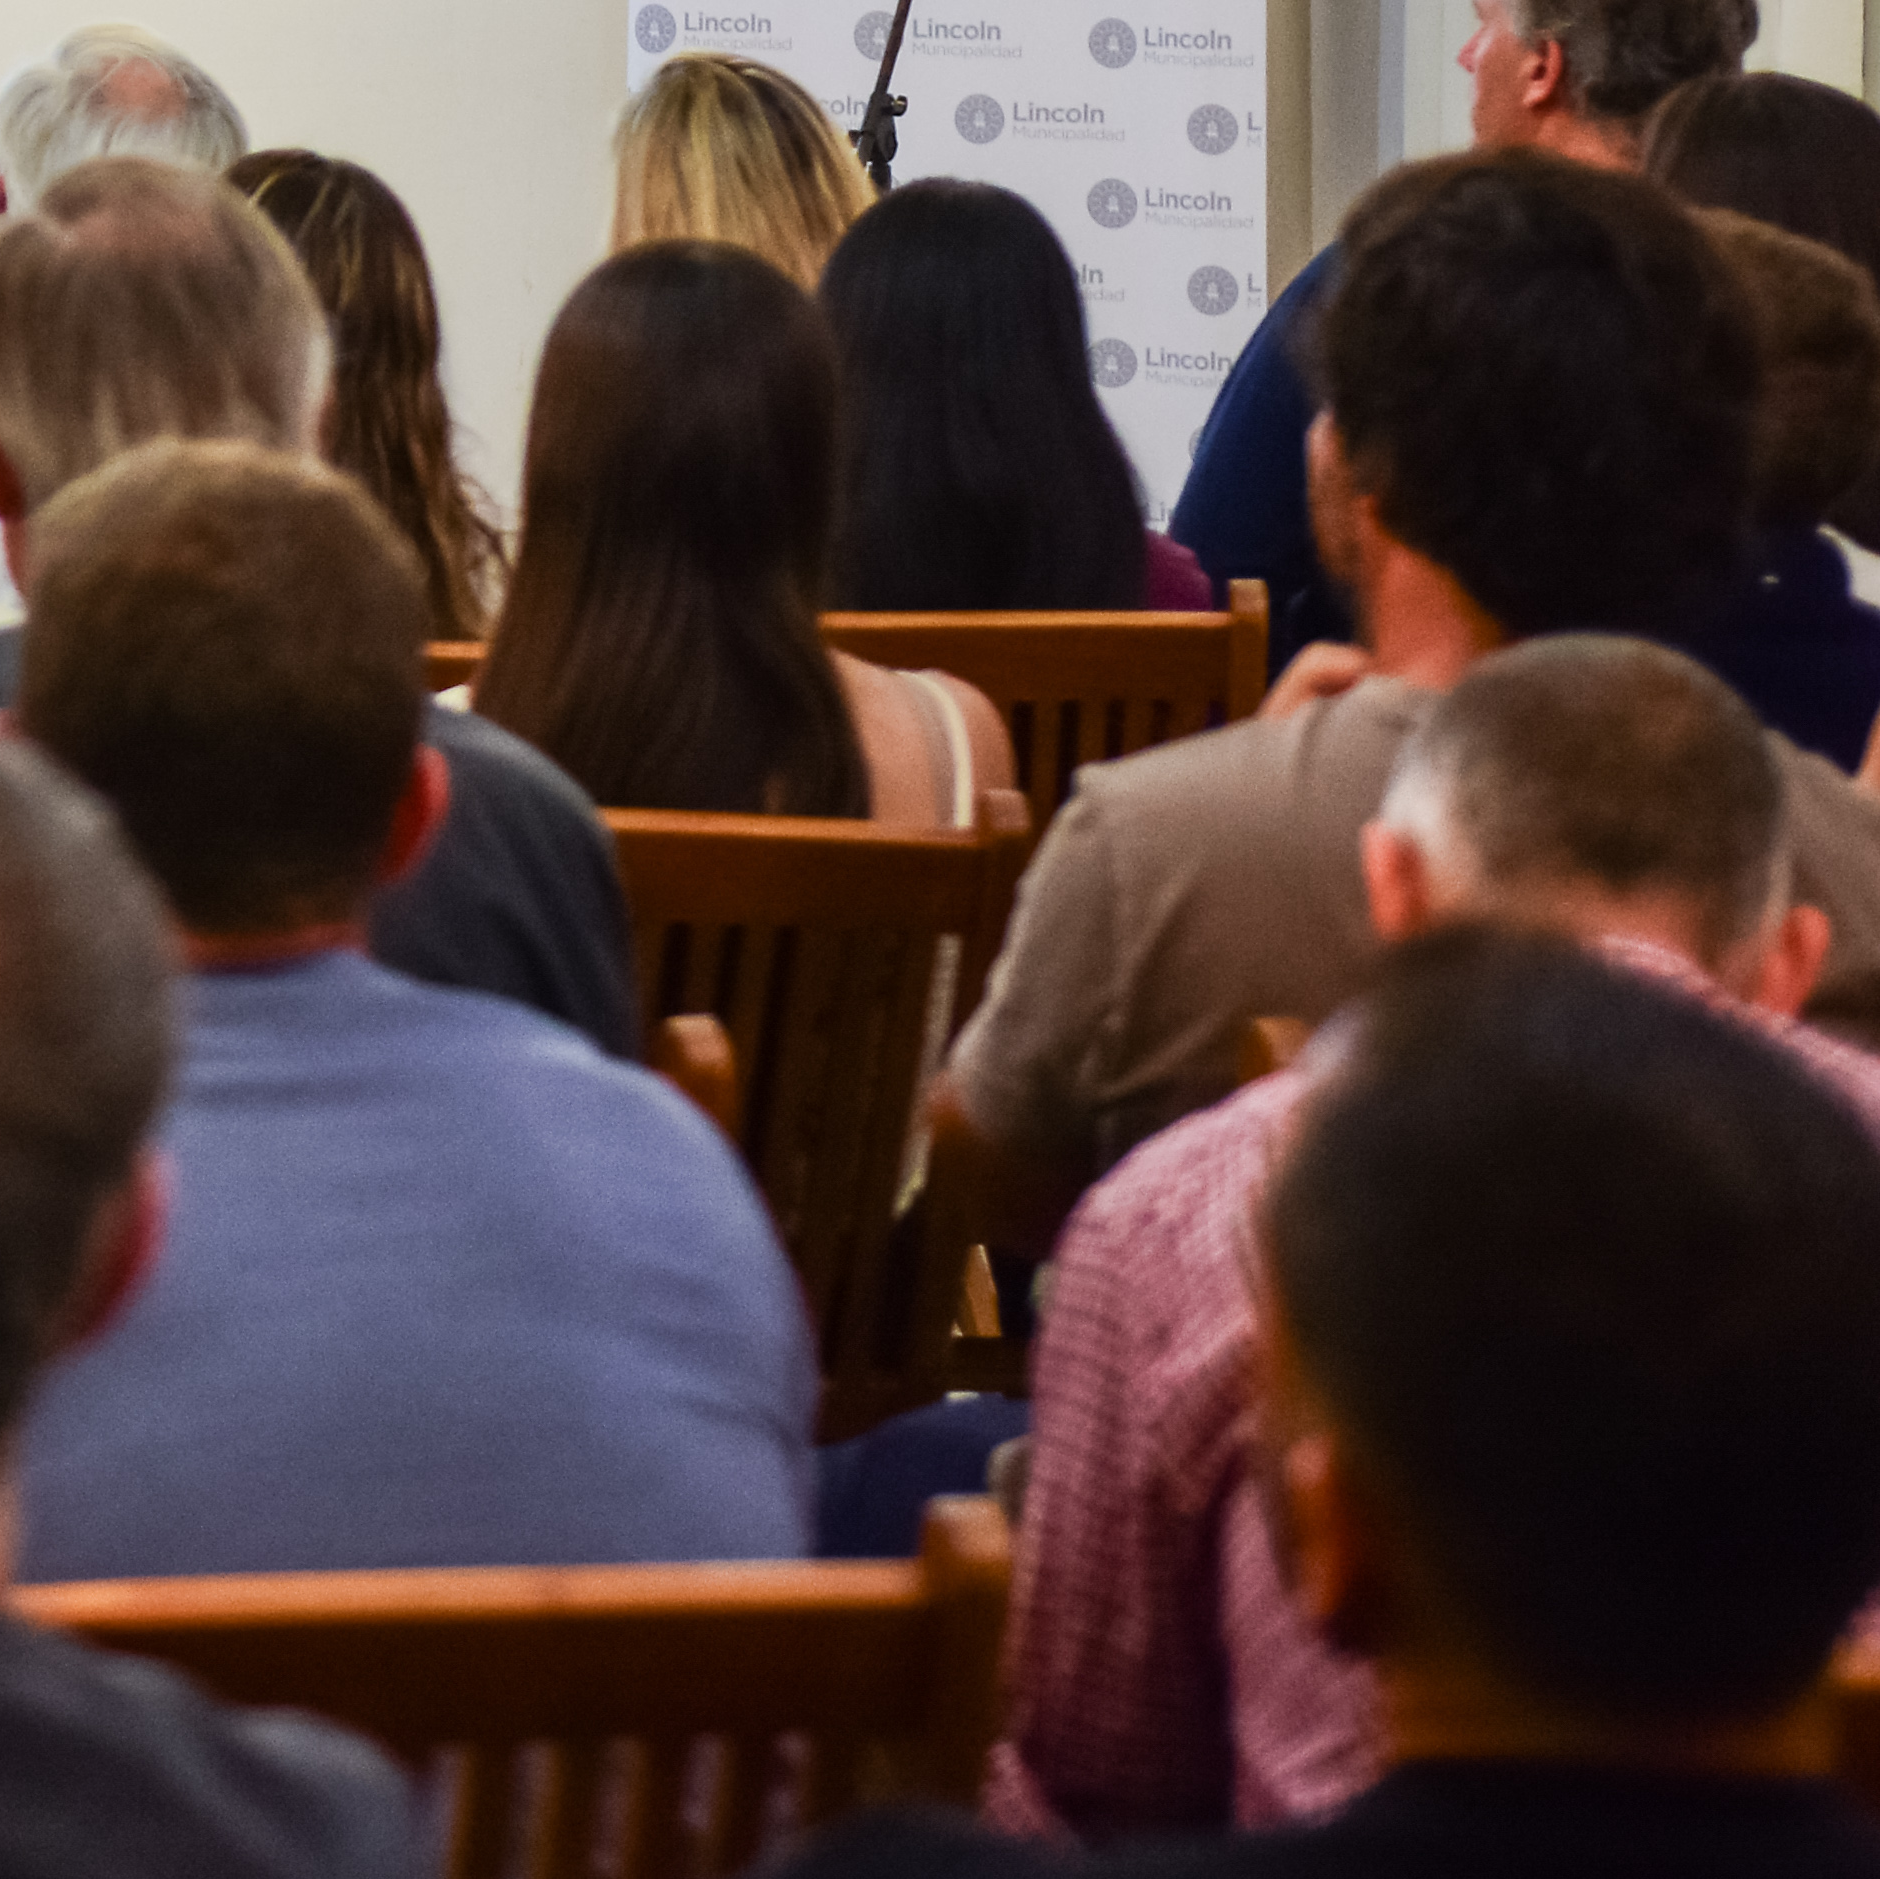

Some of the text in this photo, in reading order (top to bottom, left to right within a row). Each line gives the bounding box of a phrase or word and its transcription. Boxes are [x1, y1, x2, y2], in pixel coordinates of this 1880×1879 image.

[684, 13, 772, 34] Lincoln
[912, 19, 1002, 40] Lincoln
[1144, 28, 1232, 50] Lincoln
[1012, 102, 1105, 123] Lincoln
[1144, 189, 1232, 211] Lincoln
[1146, 347, 1232, 371] Lincoln
